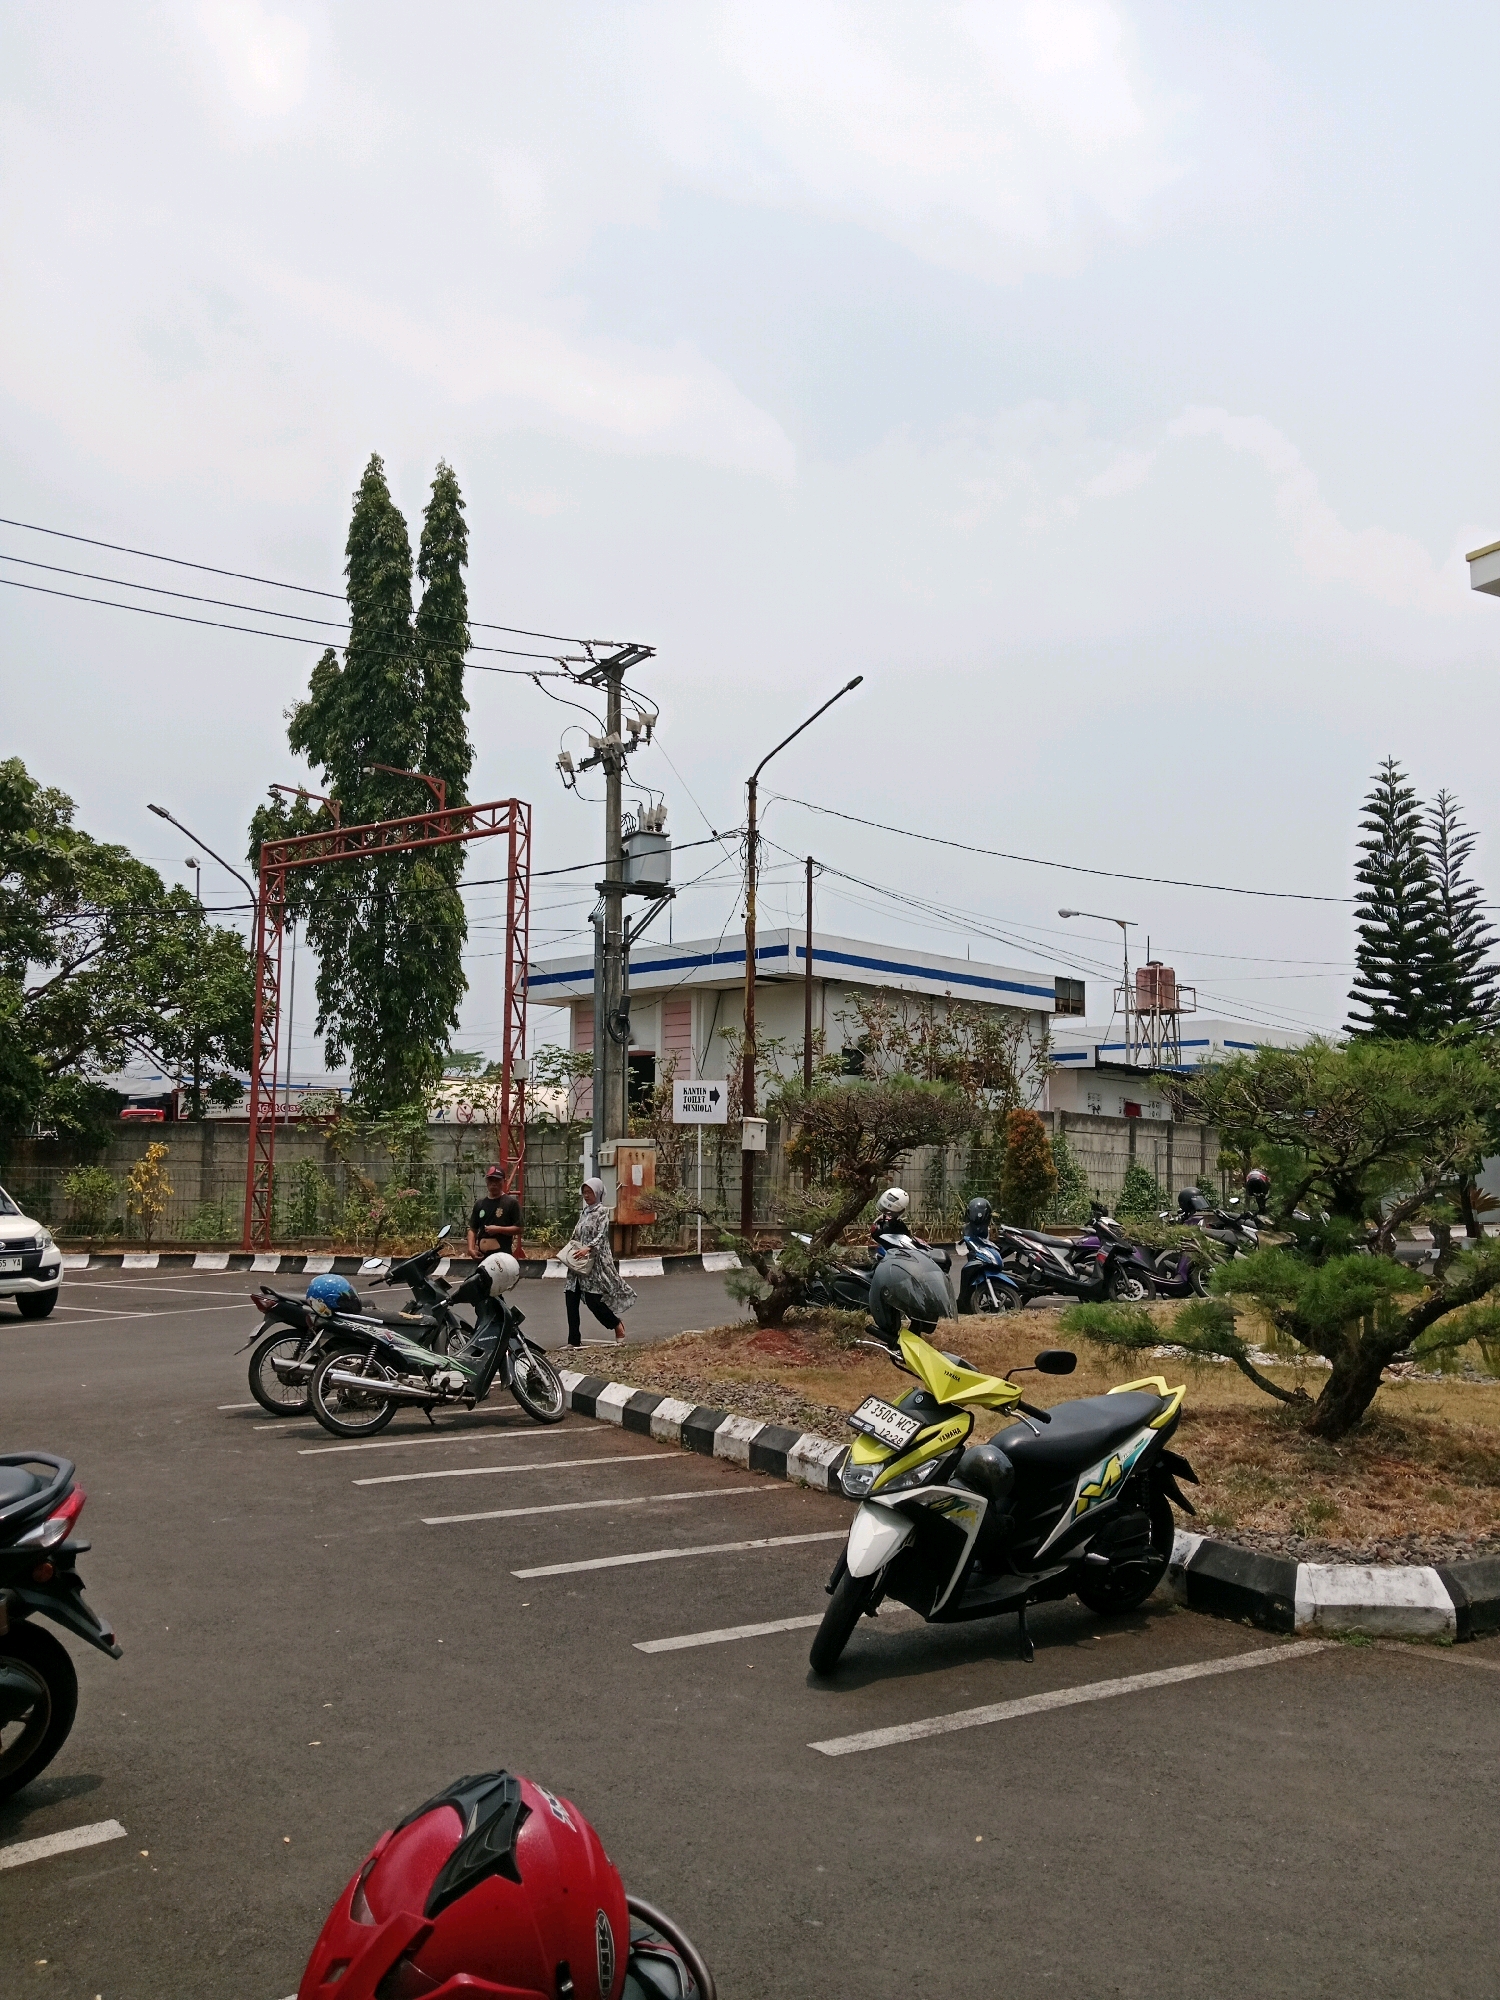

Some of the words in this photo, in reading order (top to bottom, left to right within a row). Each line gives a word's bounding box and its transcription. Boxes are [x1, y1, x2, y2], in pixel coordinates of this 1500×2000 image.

[683, 1104, 712, 1112] MUSHOLA
[12, 1258, 21, 1266] YA
[944, 1370, 961, 1382] YAMAHA
[862, 1399, 873, 1410] B
[871, 1404, 897, 1423] 3506
[896, 1417, 918, 1434] WCZ
[938, 1427, 962, 1442] YAMAHA
[597, 1914, 611, 1990] INK
